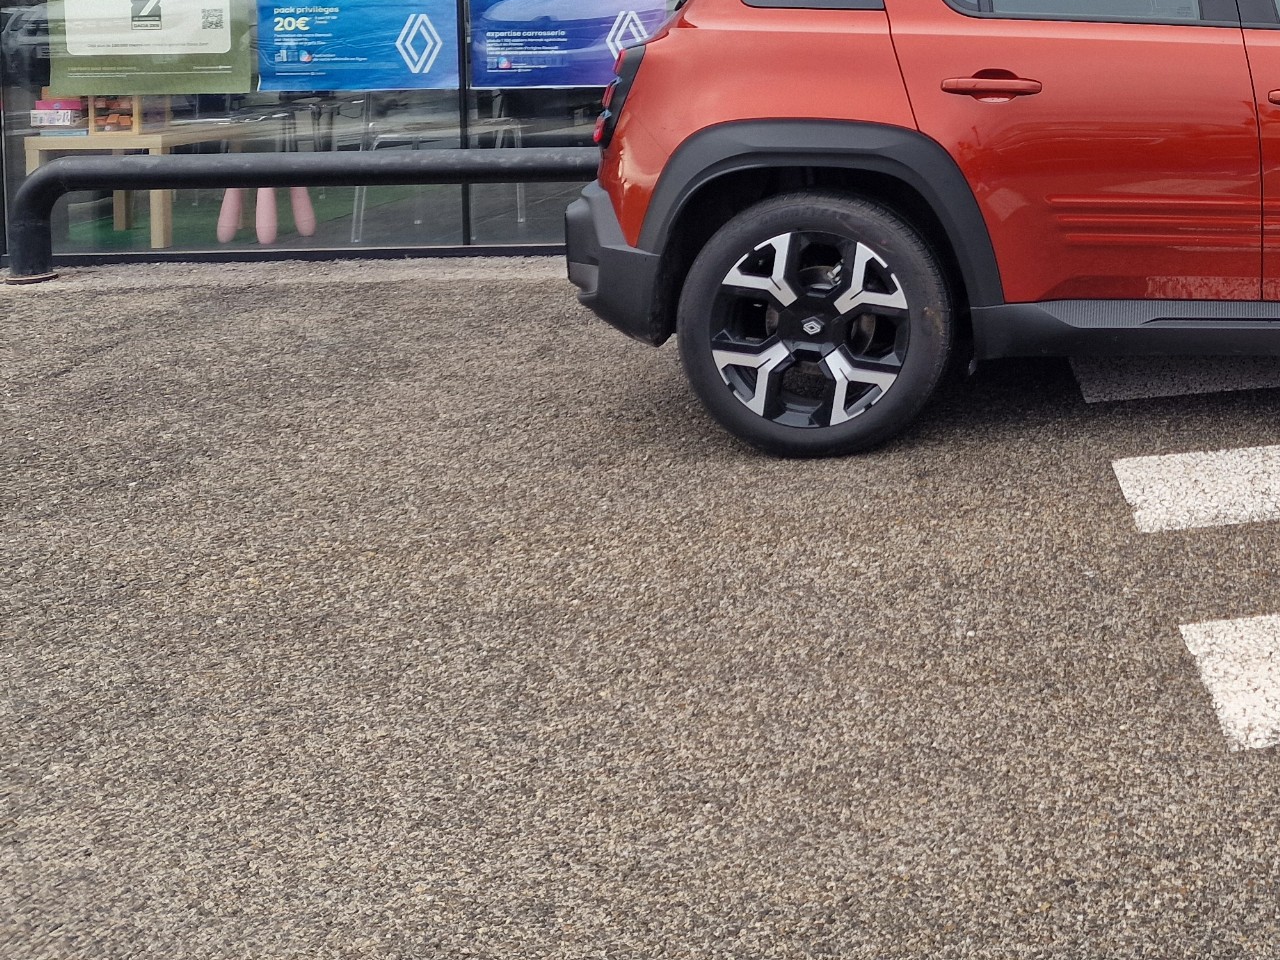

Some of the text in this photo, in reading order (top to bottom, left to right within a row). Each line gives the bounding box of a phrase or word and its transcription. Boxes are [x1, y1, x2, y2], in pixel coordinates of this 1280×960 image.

[273, 6, 295, 15] pack
[273, 16, 311, 31] 20€
[486, 29, 566, 38] expertise carrosserie
